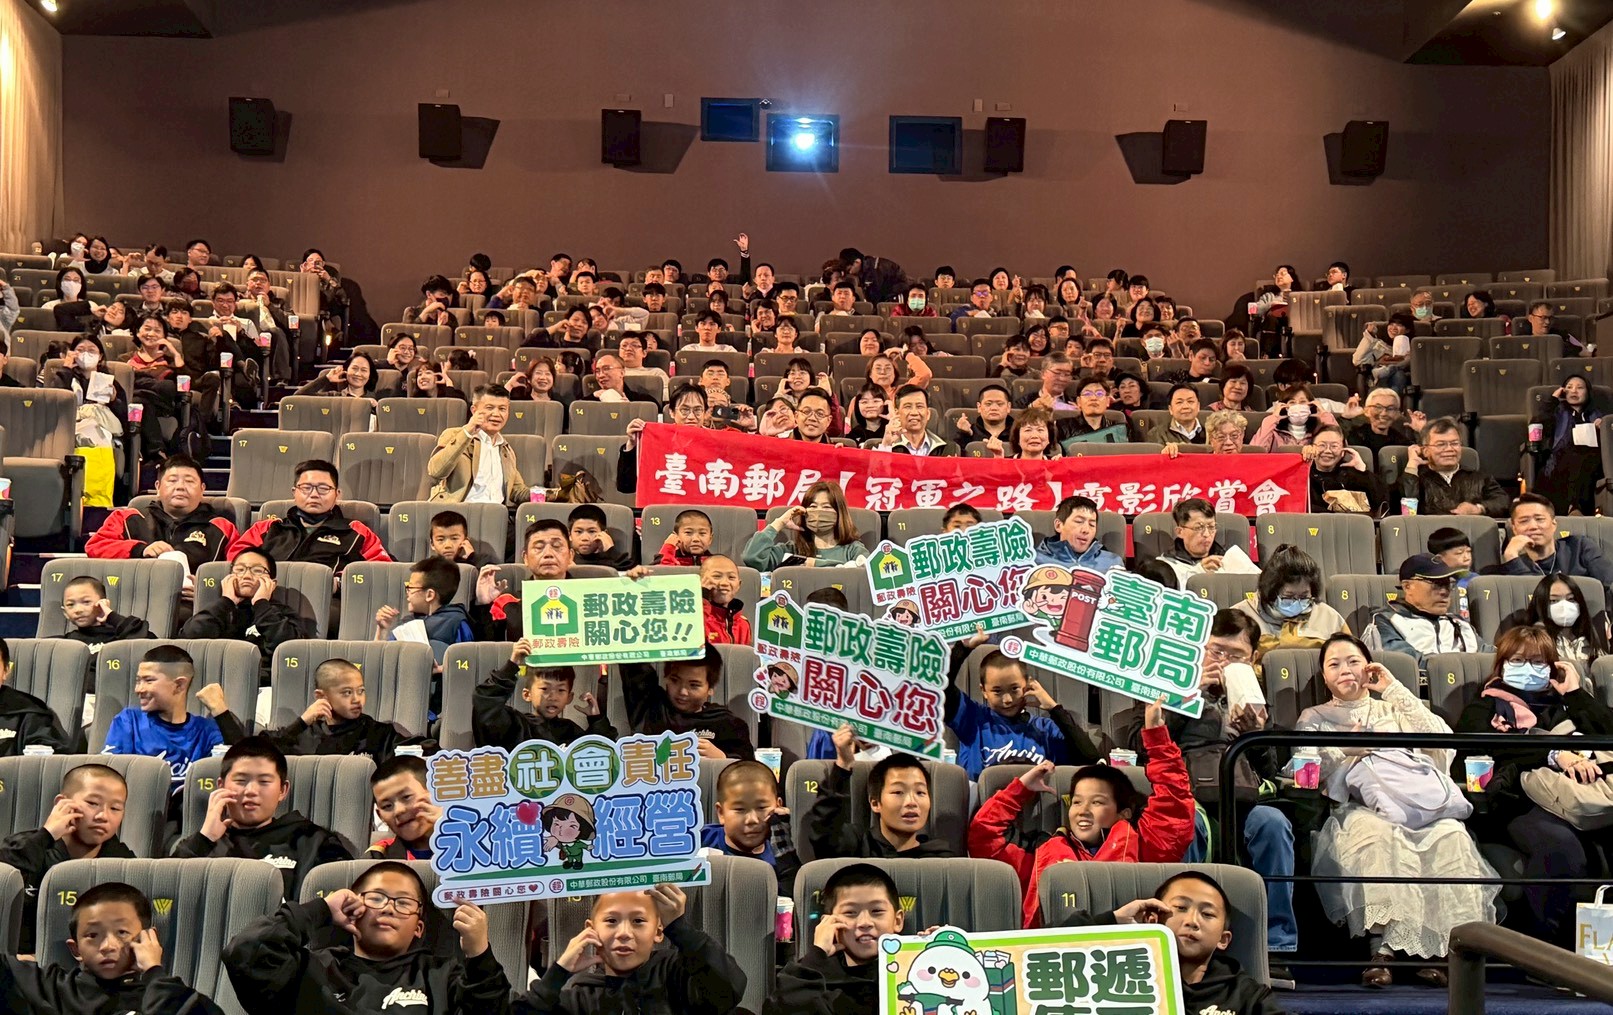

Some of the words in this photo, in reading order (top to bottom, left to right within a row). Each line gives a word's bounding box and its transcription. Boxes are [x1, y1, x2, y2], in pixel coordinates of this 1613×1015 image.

[346, 443, 356, 451] 16
[558, 444, 567, 452] 14
[1391, 455, 1396, 464] 6
[398, 513, 409, 522] 15
[525, 514, 535, 522] 14
[650, 517, 660, 526] 13
[898, 522, 906, 531] 11
[1145, 525, 1152, 535] 9
[1268, 525, 1275, 535] 8
[1393, 527, 1399, 536] 7
[910, 520, 1034, 580] 郵政壽險
[51, 573, 63, 582] 17
[203, 578, 215, 588] 16
[352, 574, 364, 584] 15
[781, 579, 793, 589] 12
[1071, 590, 1097, 605] POST
[1201, 588, 1208, 598] 9
[1341, 590, 1349, 600] 8
[1483, 590, 1491, 601] 7
[583, 588, 696, 618] 郵政壽險
[1109, 573, 1211, 643] 臺南
[532, 636, 580, 649] 郵政壽險
[805, 608, 943, 686] 郵政壽險
[1092, 620, 1200, 689] 郵局
[106, 660, 120, 670] 16
[285, 657, 299, 668] 15
[456, 659, 469, 670] 14
[1029, 649, 1126, 688] 中華郵政股份有限公司
[1281, 668, 1289, 679] 9
[1447, 673, 1456, 685] 8
[803, 659, 938, 734] 關心您
[434, 740, 695, 800] 善盡社會責任
[197, 778, 214, 791] 15
[804, 780, 819, 794] 12
[570, 876, 648, 890] 中華郵政股份有限公司
[57, 890, 78, 906] 15
[1062, 893, 1077, 908] 11
[1026, 947, 1156, 1003] 郵遞
